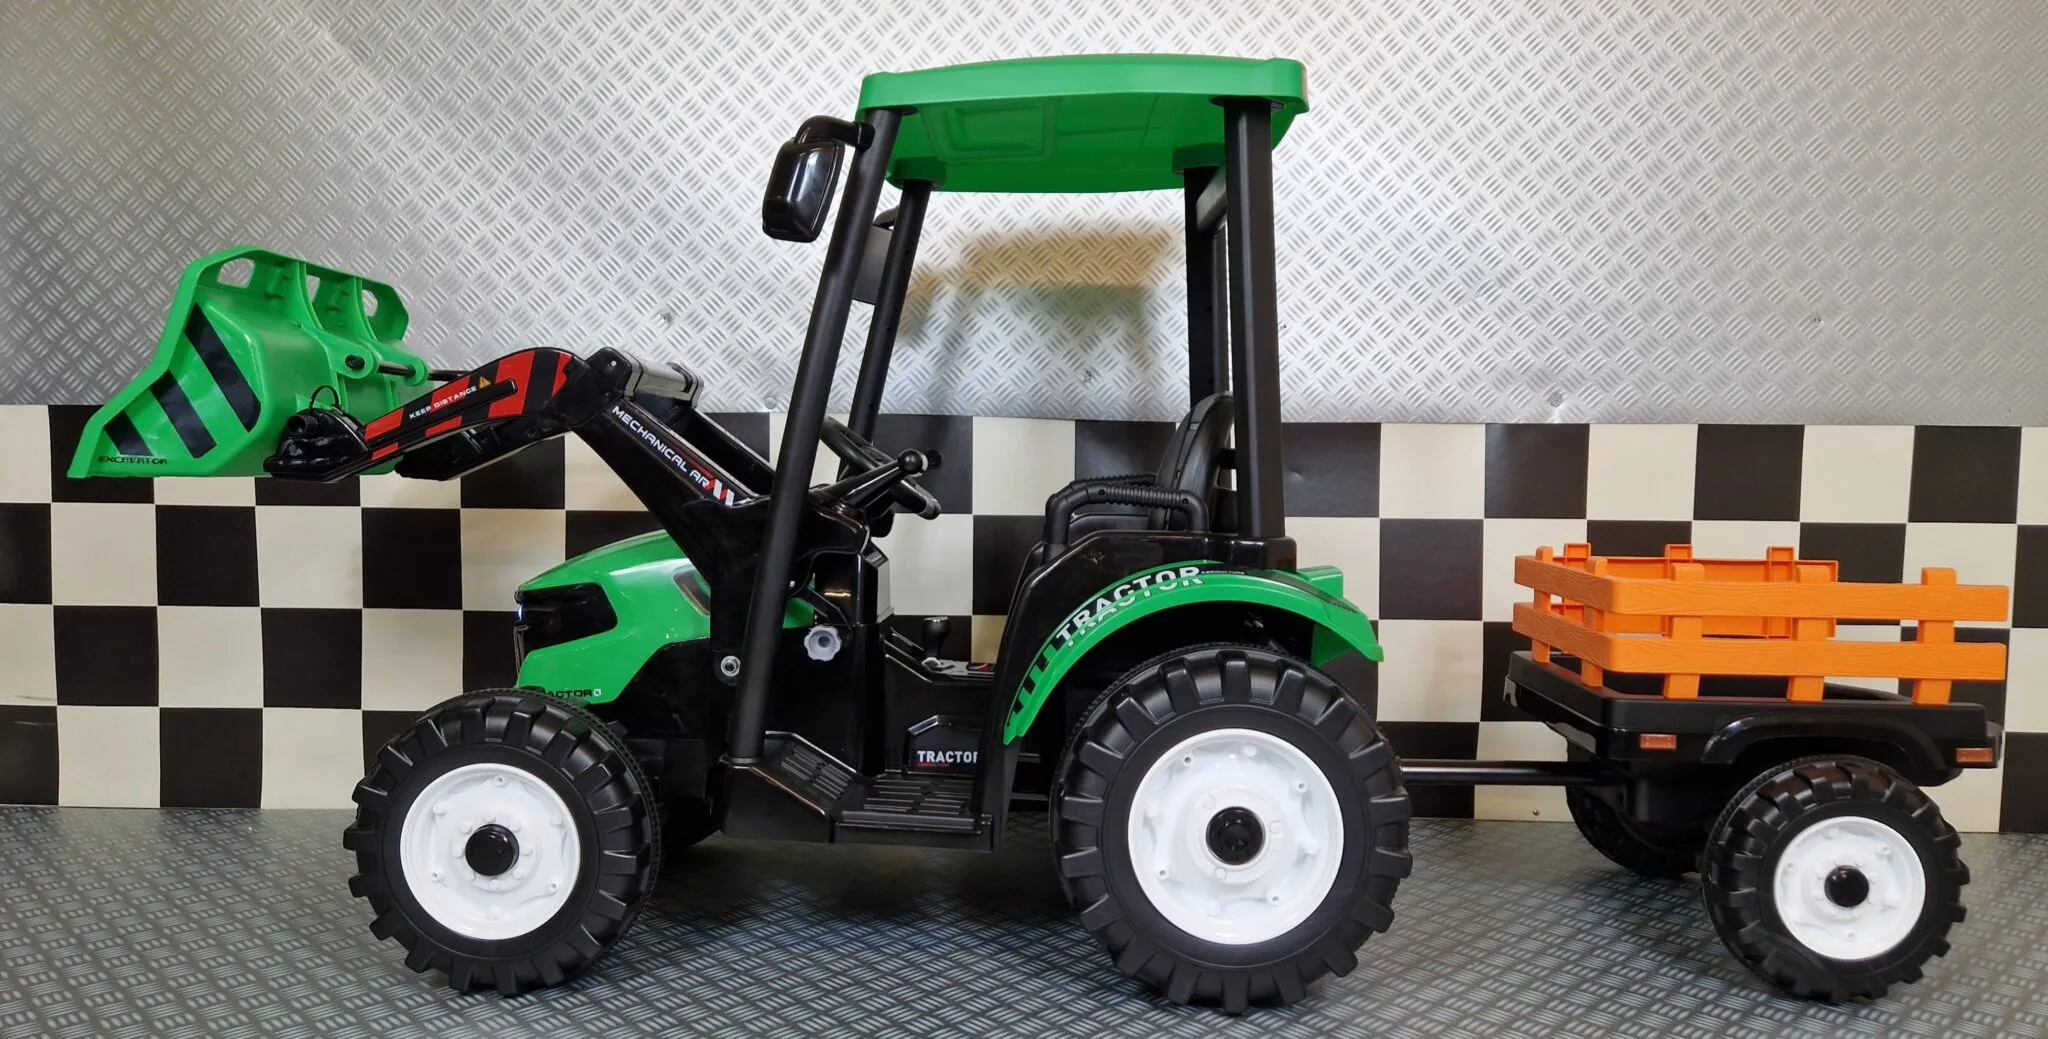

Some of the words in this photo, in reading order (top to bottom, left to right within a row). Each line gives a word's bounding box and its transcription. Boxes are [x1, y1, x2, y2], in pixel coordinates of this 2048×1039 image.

[409, 405, 432, 419] KEEP
[433, 385, 477, 408] DISTANCE
[612, 405, 688, 472] MECHANICAL
[1056, 566, 1203, 647] TRACTOR
[547, 689, 593, 699] ACTOR
